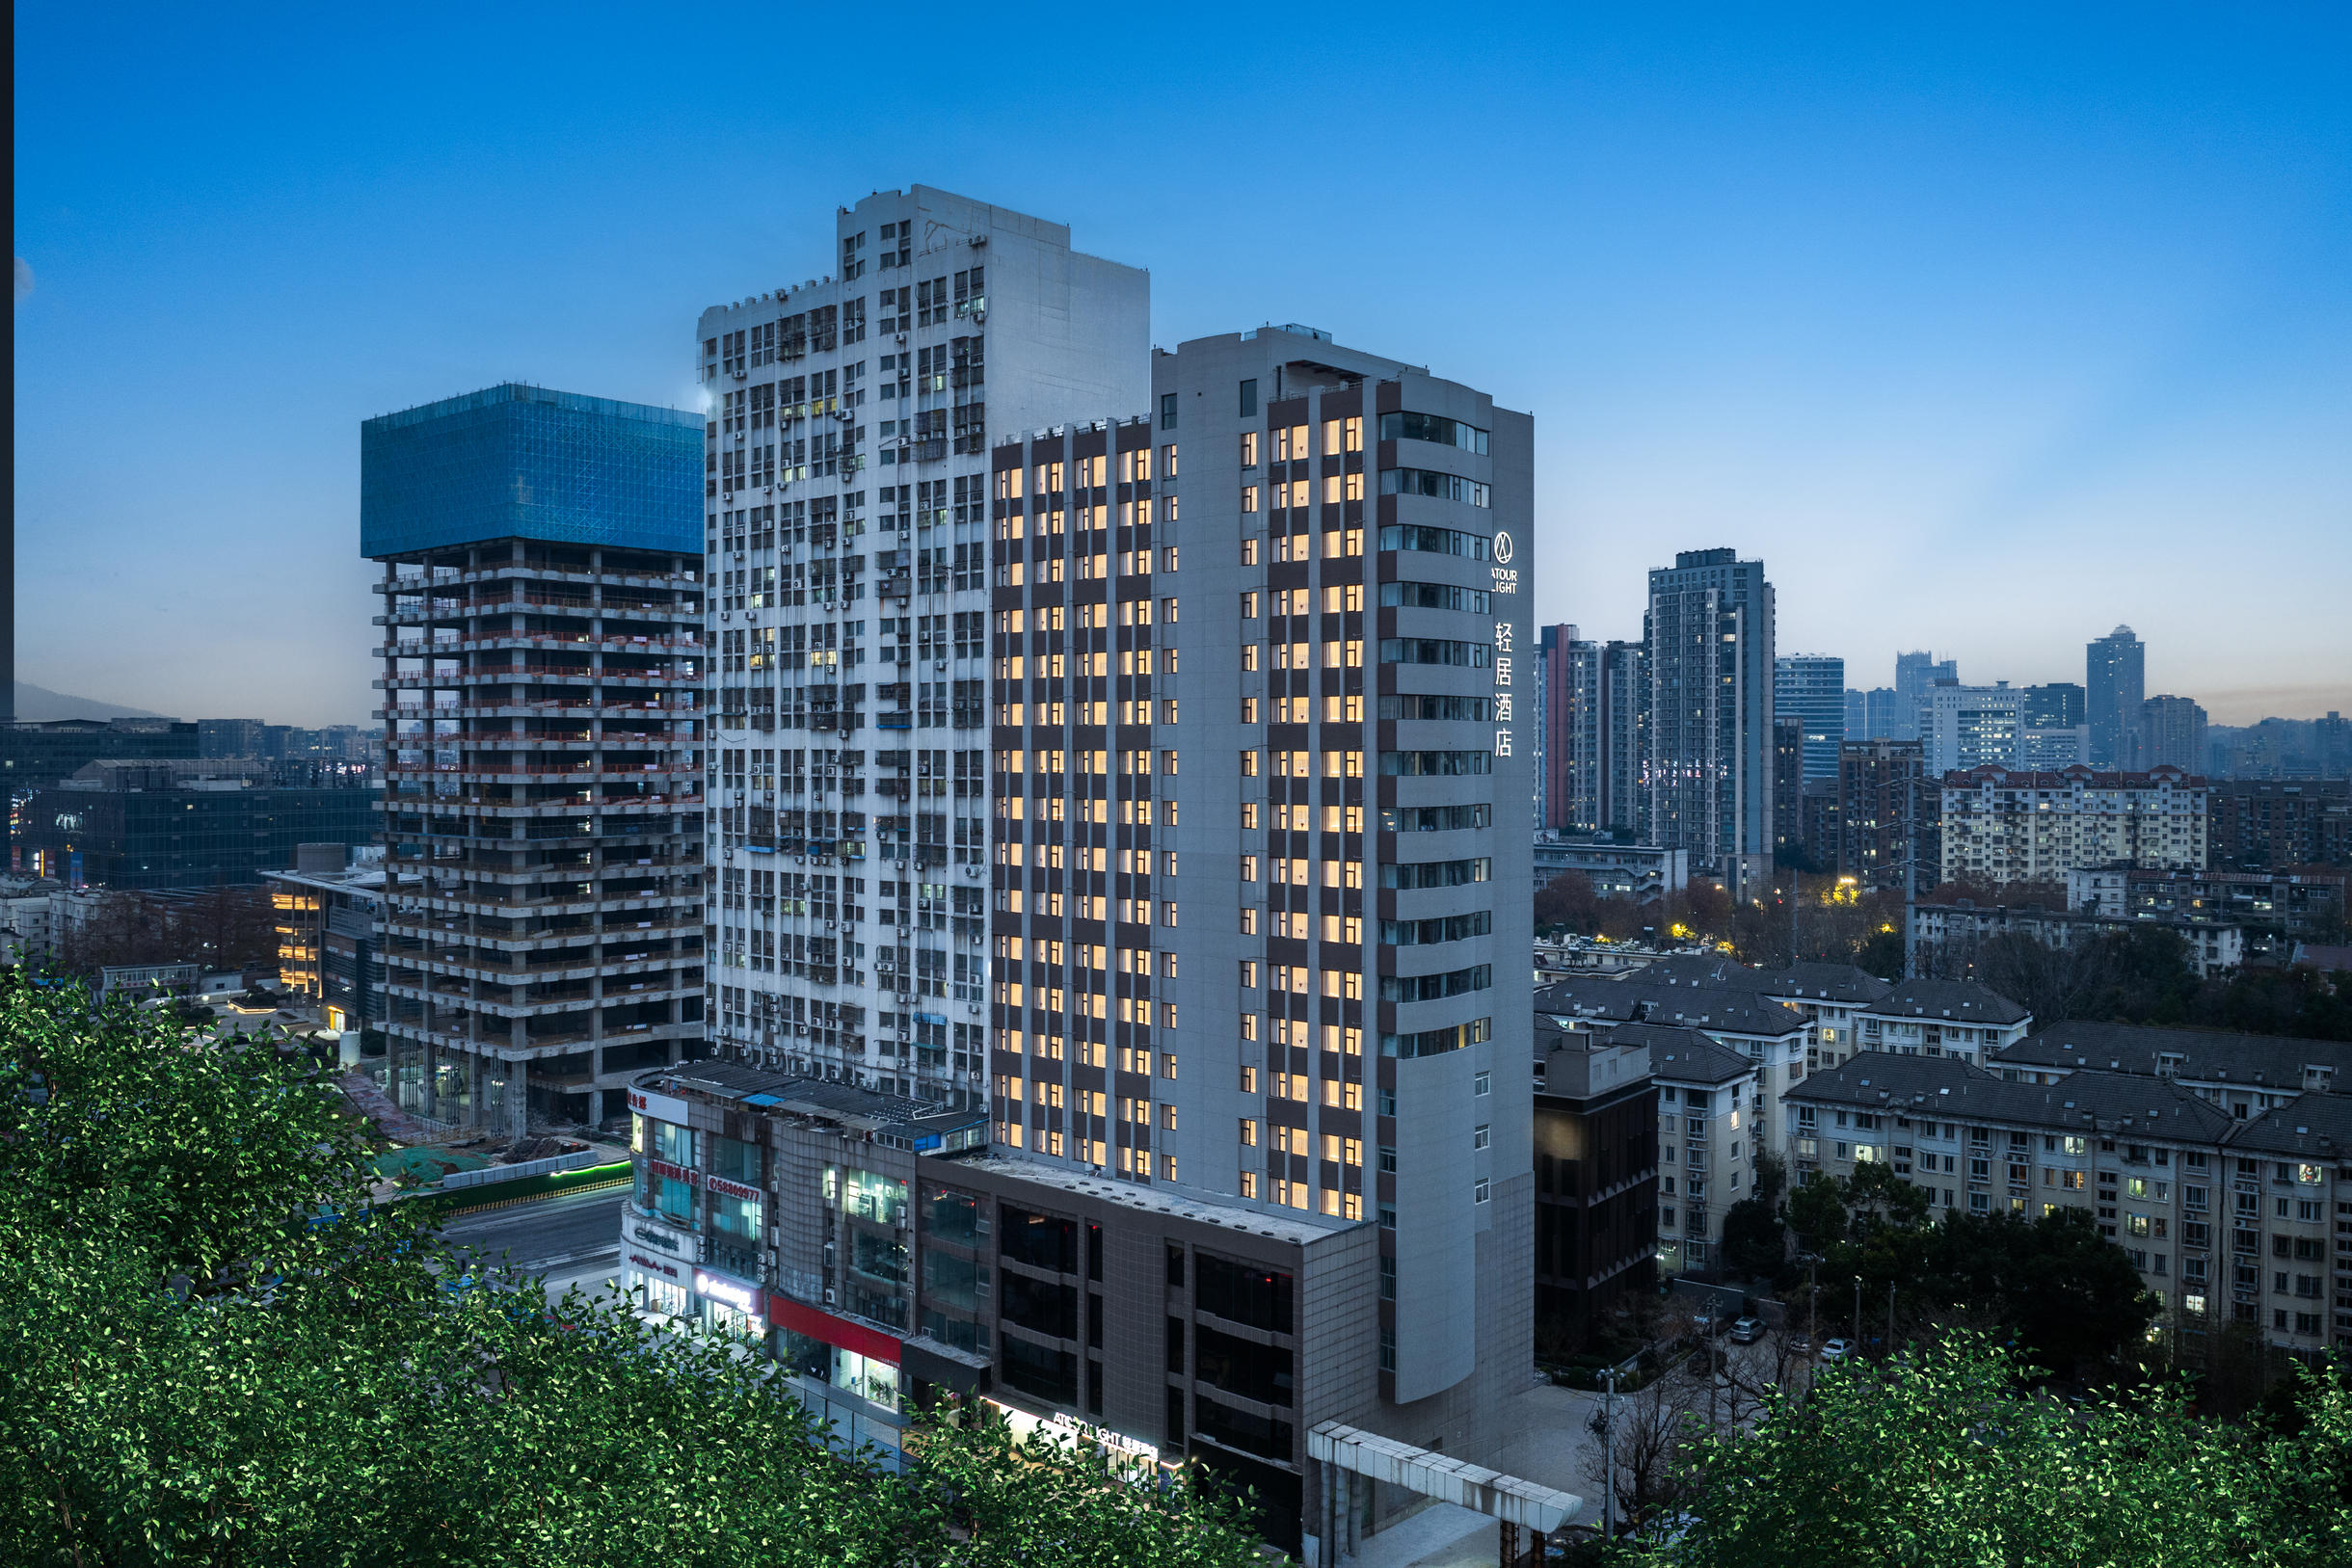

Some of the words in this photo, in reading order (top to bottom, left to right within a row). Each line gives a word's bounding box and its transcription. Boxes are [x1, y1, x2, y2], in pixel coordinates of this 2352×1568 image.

[1495, 622, 1512, 757] 轻居酒店
[1089, 1423, 1121, 1446] IGHT
